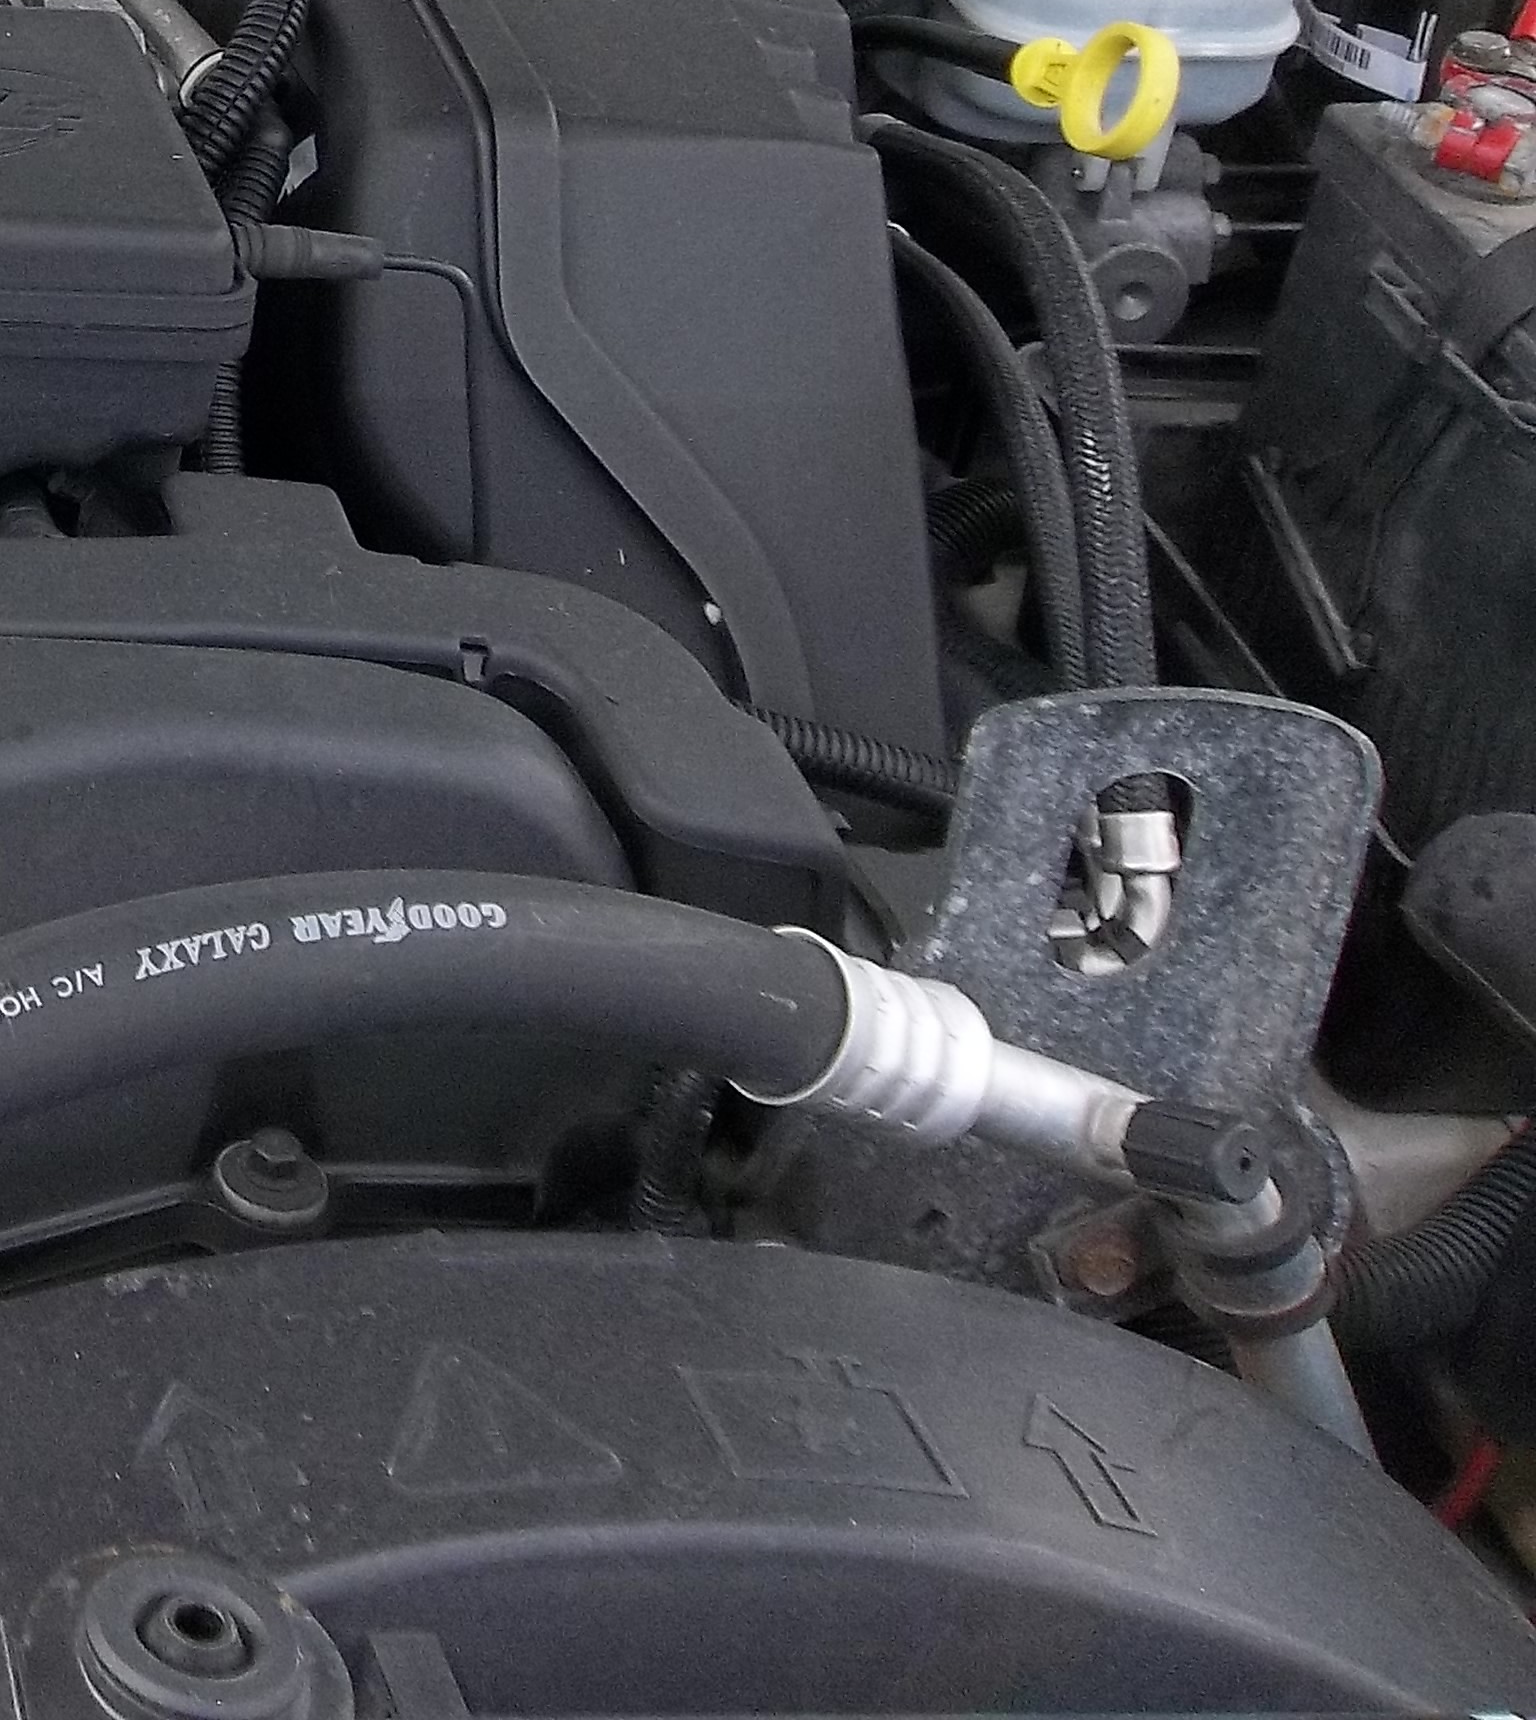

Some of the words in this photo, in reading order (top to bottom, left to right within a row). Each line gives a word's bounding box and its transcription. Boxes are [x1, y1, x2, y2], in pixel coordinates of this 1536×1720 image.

[289, 896, 508, 944] GOODYEAR
[134, 922, 271, 981] GALAXY
[51, 962, 105, 999] A/C
